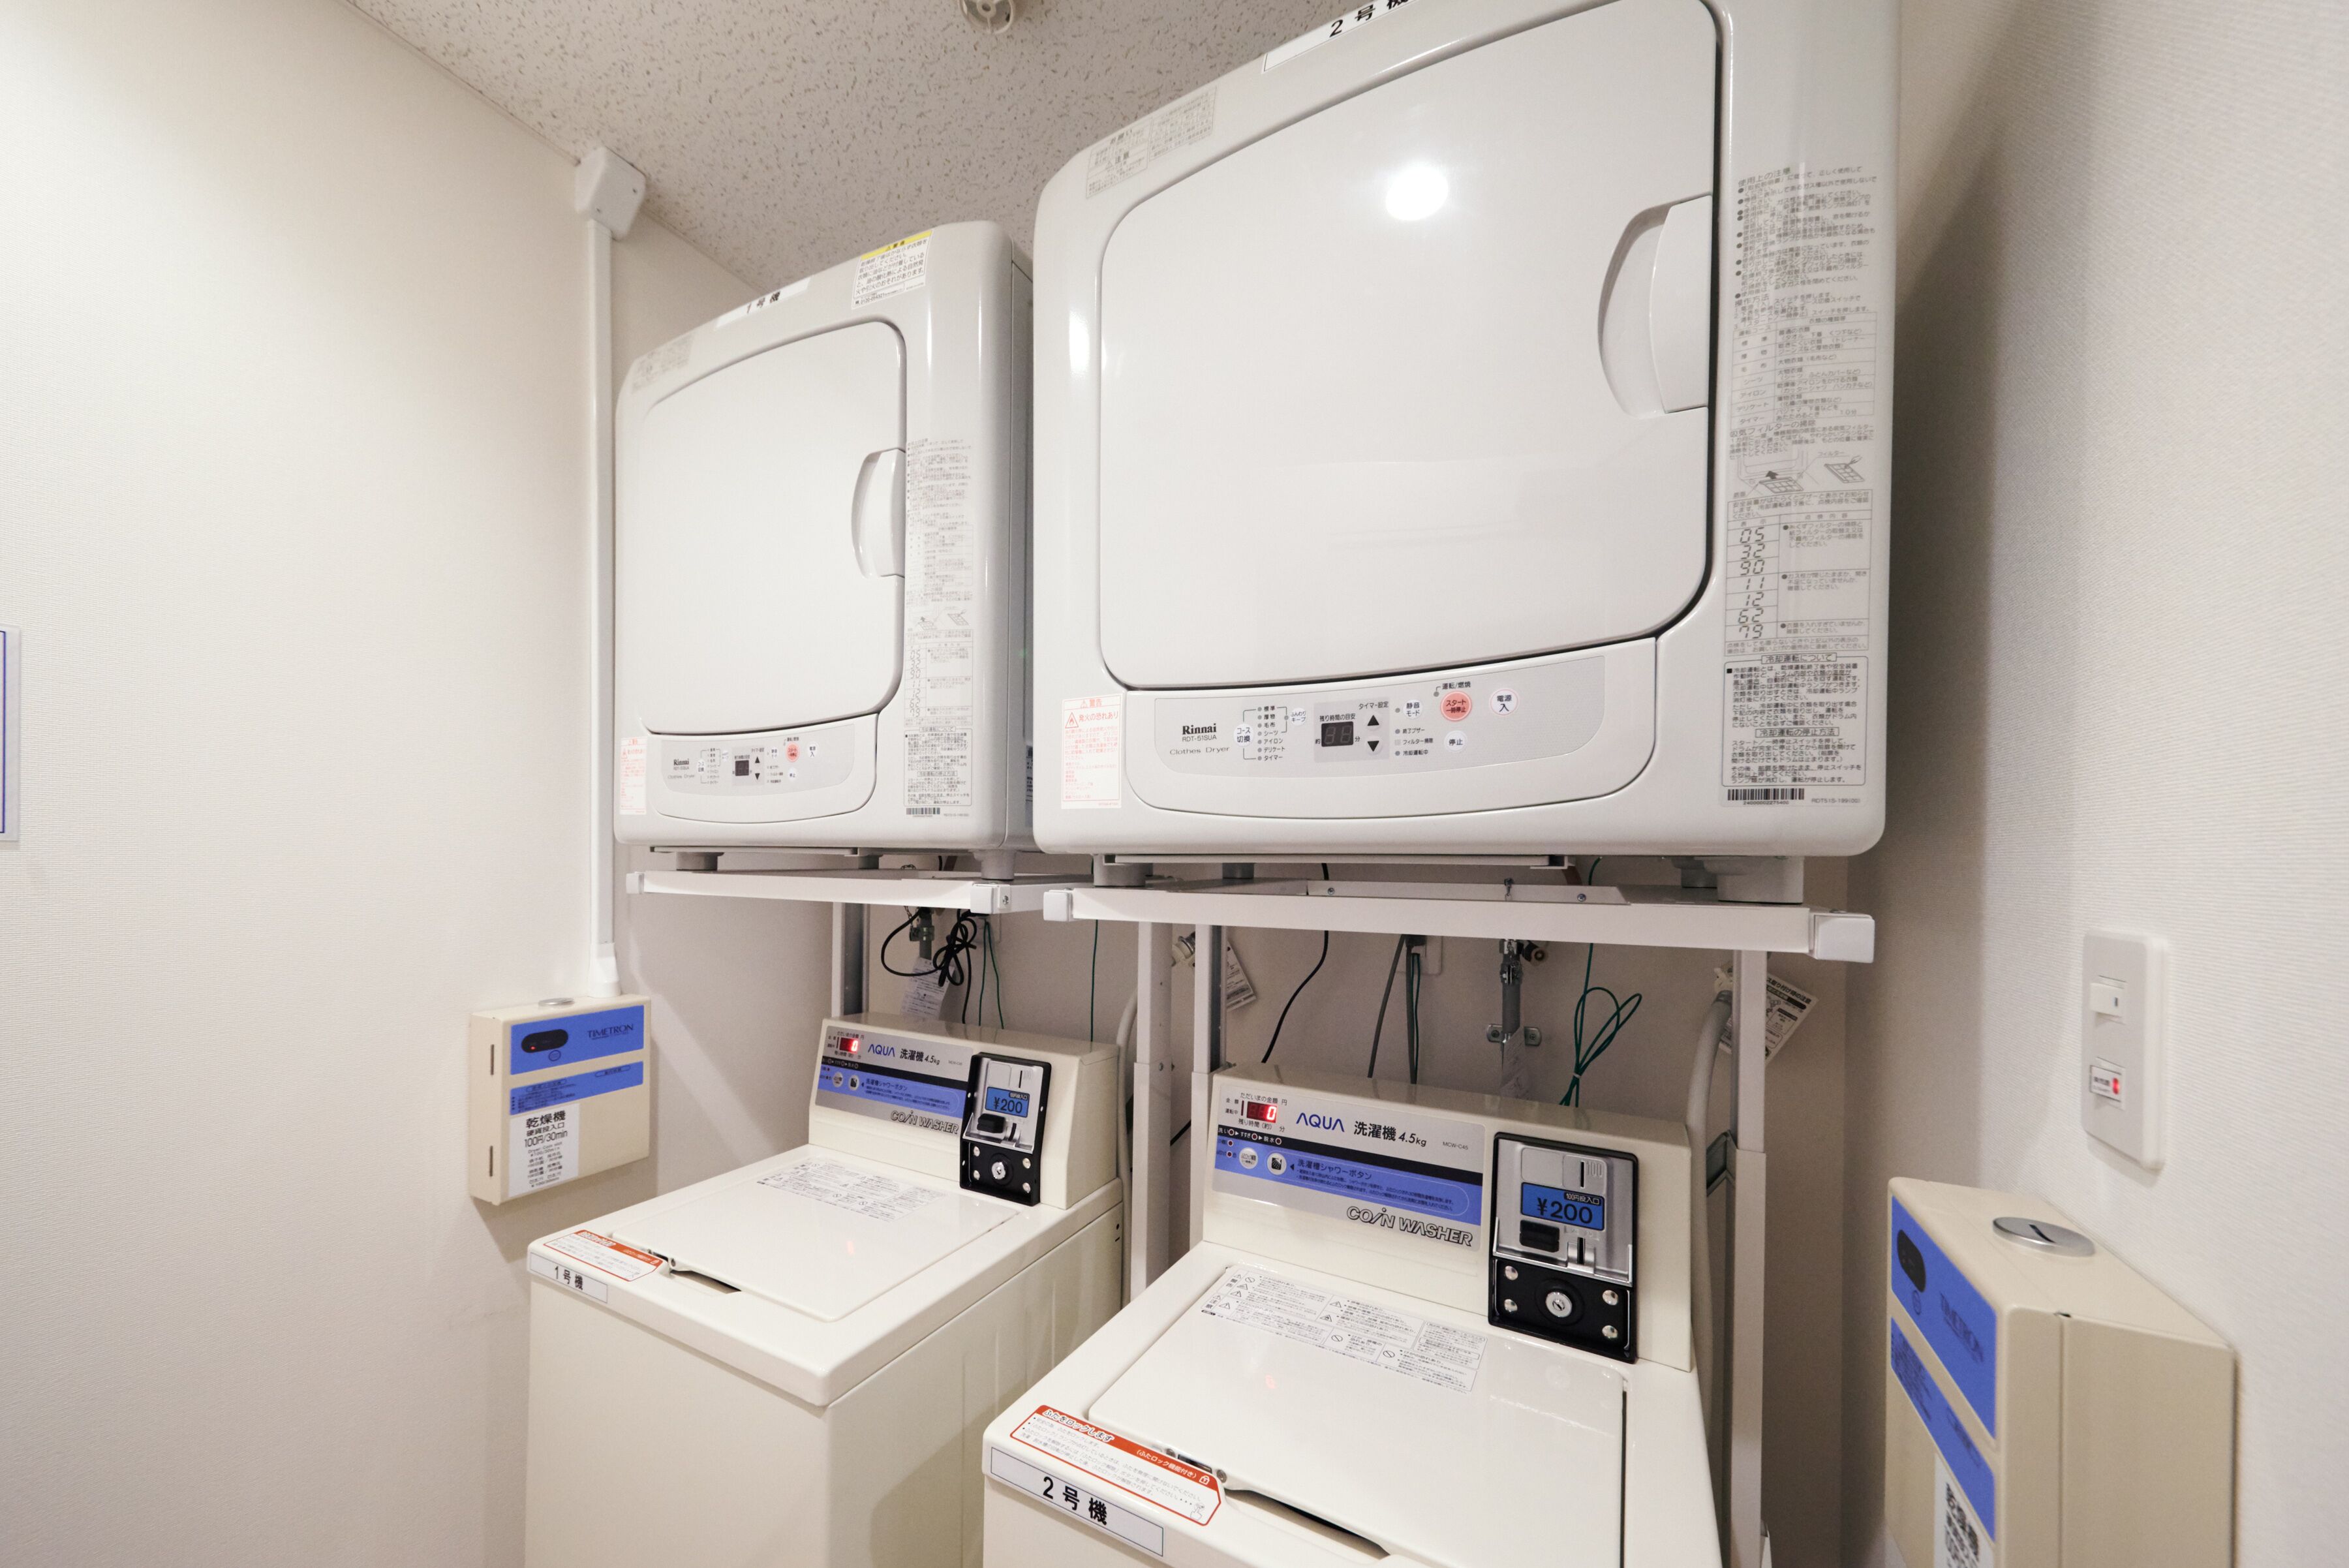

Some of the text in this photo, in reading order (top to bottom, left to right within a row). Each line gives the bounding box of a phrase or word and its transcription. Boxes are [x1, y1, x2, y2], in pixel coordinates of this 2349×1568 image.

[1740, 542, 1766, 560] 32
[1740, 559, 1765, 576] 90
[1746, 576, 1765, 590] 11
[1745, 591, 1764, 607] 12
[1738, 607, 1764, 624] 62
[1765, 654, 1833, 663] 冷却運転について
[1359, 701, 1389, 710] タイマー設定
[1498, 703, 1509, 713] 入
[1079, 711, 1119, 722] 発火の恐れあり
[1319, 713, 1356, 722] 残り時間の目安
[1182, 723, 1217, 735] Rinnai
[1759, 728, 1836, 737] 冷却運転の停止方法
[588, 1024, 634, 1038] TIMETRON
[851, 1039, 859, 1052] 0
[868, 1043, 895, 1057] AQUA
[899, 1048, 924, 1062] 洗濯機
[924, 1055, 940, 1065] 4.5kg
[993, 1096, 1023, 1114] ¥200
[1240, 1092, 1278, 1104] ただいまの金額
[526, 1110, 566, 1129] 乾燥機
[1267, 1105, 1277, 1120] 0
[919, 1116, 959, 1135] WASHER
[1296, 1112, 1345, 1133] AQUA
[1353, 1120, 1397, 1142] 洗濯機
[1398, 1132, 1427, 1147] 4.5kg
[1297, 1159, 1372, 1180] 洗濯槽シャワーボタン
[1565, 1193, 1600, 1205] 100円投入口
[1537, 1197, 1593, 1224] ¥200
[1399, 1216, 1473, 1247] WASHER
[555, 1265, 583, 1291] 1号機
[1043, 1409, 1114, 1442] ふたをロックします
[1043, 1476, 1107, 1526] 2号機
